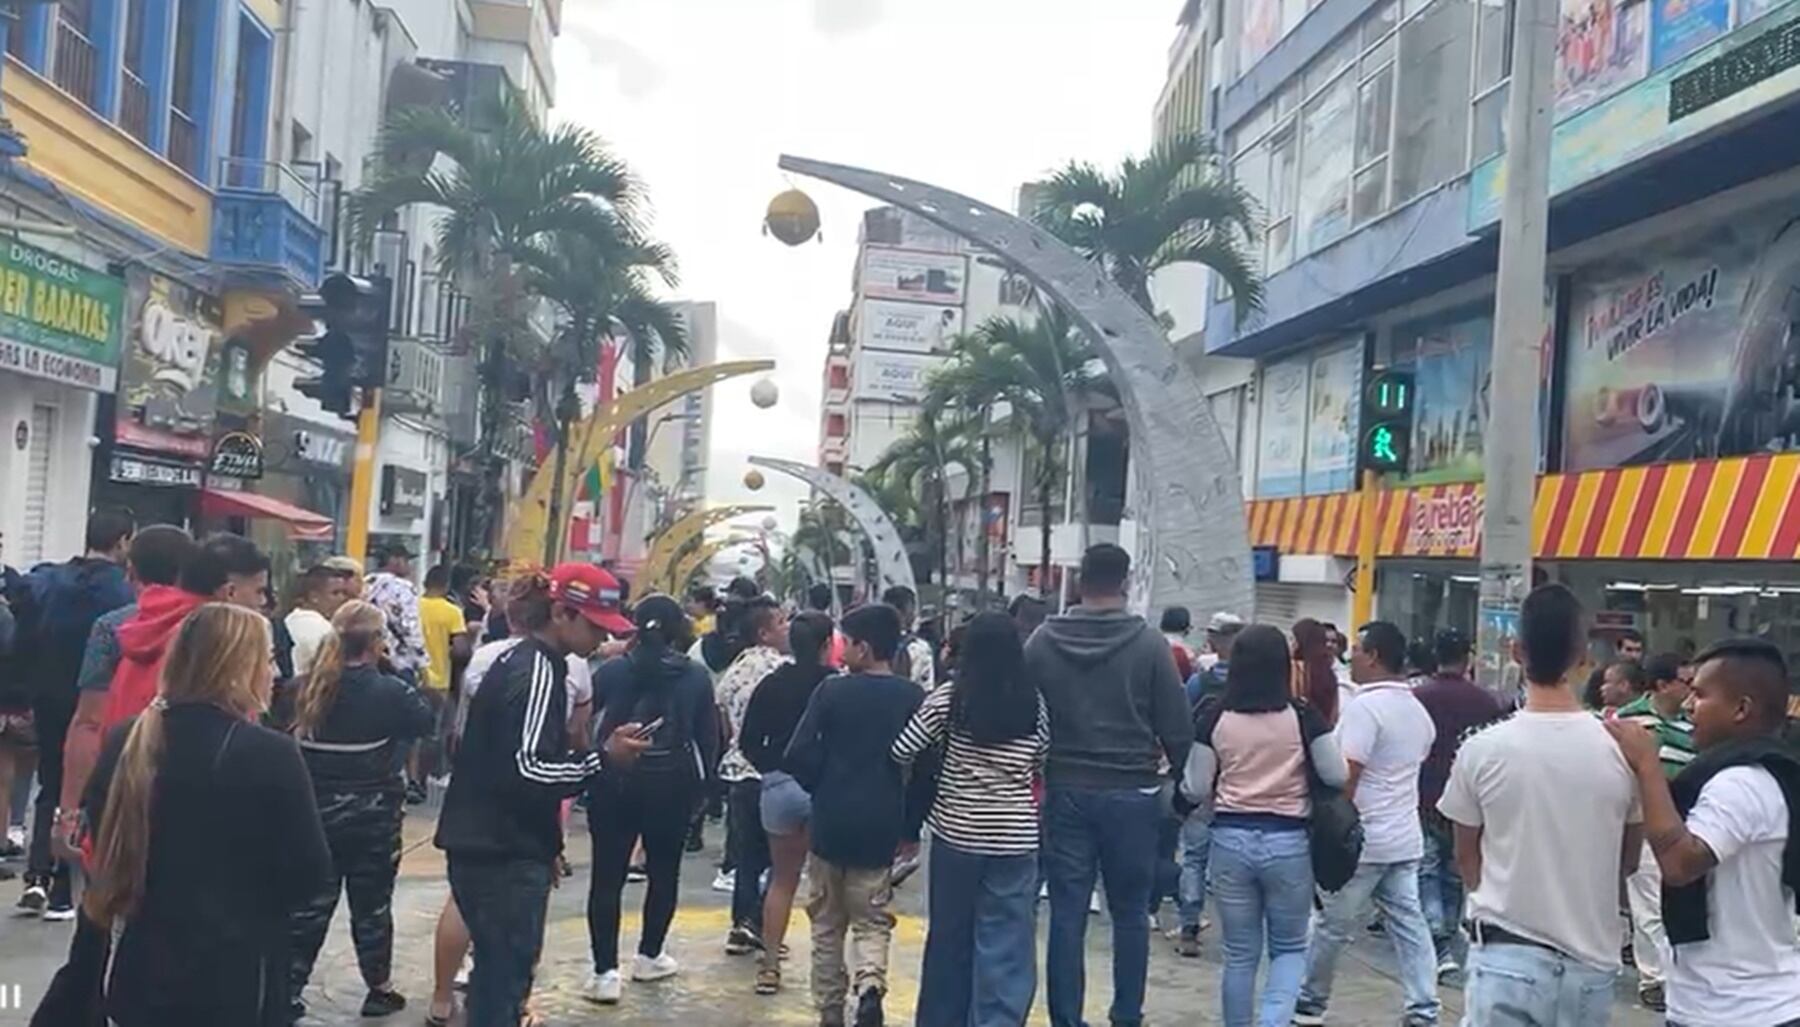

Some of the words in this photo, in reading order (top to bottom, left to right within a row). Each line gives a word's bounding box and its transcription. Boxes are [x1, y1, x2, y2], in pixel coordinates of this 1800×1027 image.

[10, 244, 80, 282] DROGAS
[33, 279, 110, 343] BARATAS
[1647, 302, 1665, 333] LA
[1670, 267, 1718, 318] VIDA!
[25, 348, 39, 371] LA
